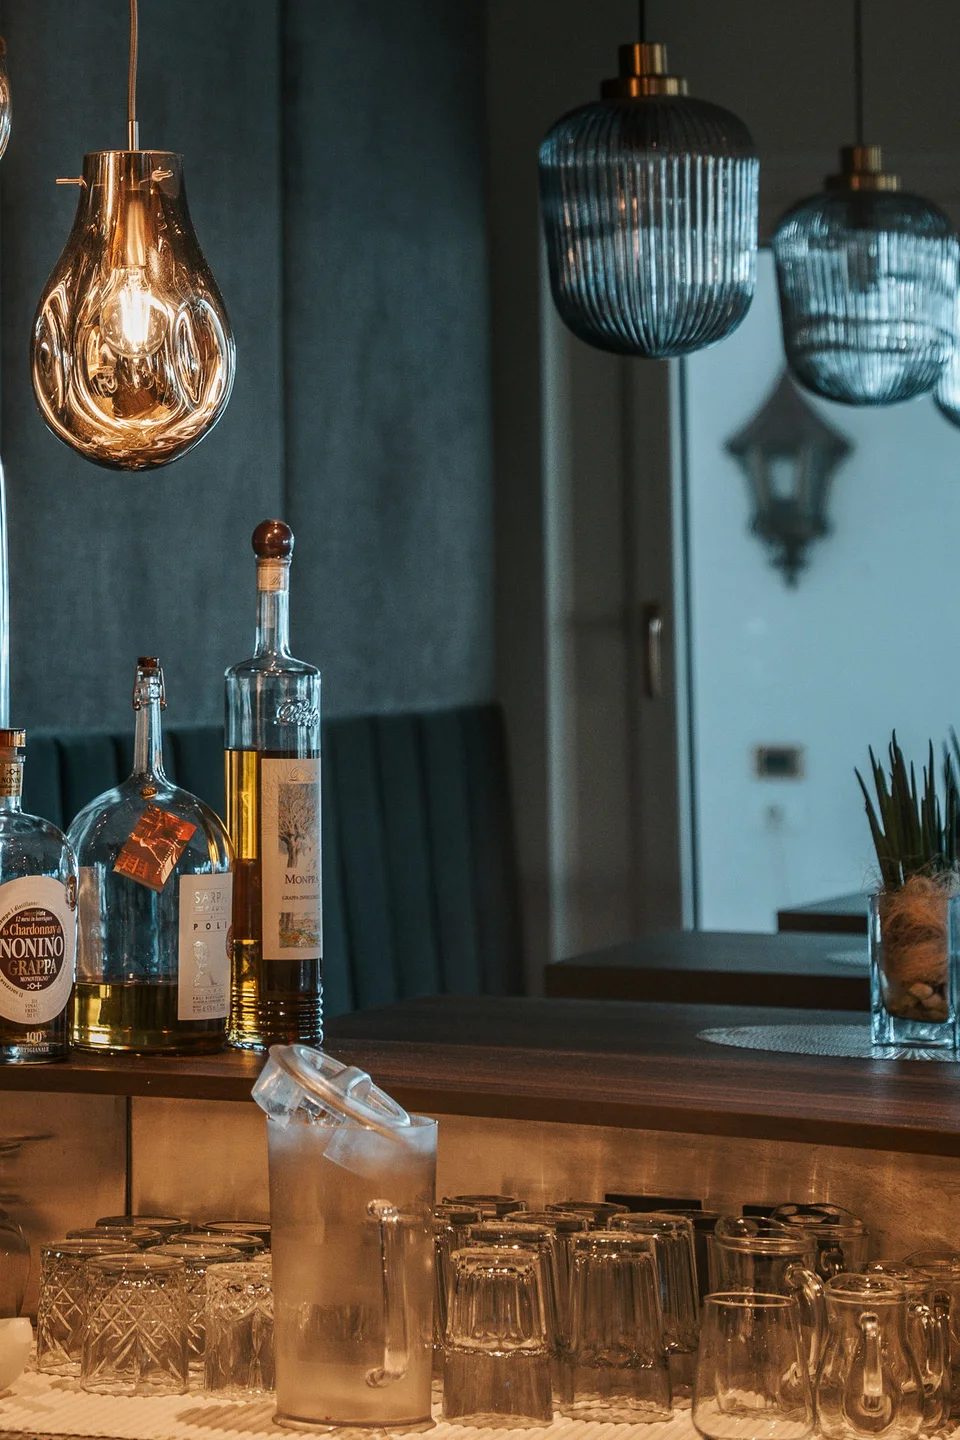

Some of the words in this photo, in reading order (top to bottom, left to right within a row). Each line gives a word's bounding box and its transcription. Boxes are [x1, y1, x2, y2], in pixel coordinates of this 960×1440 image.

[9, 923, 57, 937] Chardonnay
[193, 921, 227, 931] POLI
[8, 958, 57, 976] GRAPPA
